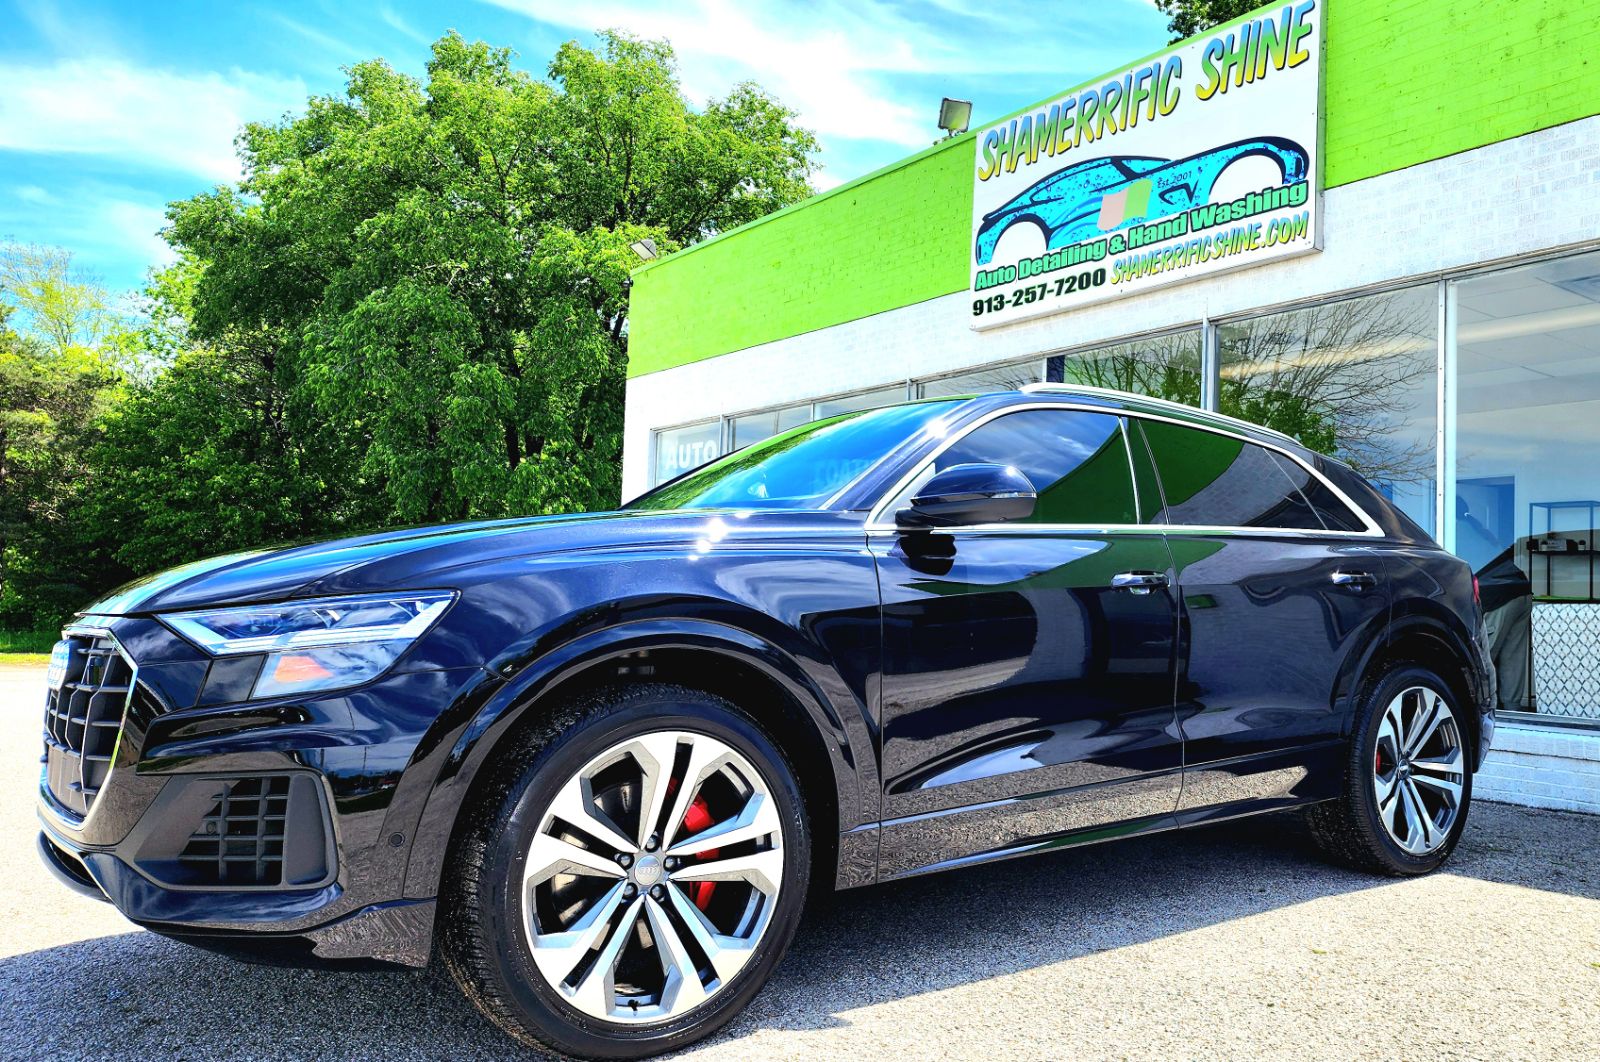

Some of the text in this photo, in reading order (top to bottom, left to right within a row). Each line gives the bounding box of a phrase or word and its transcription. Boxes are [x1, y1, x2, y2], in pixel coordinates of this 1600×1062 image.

[977, 0, 1316, 181] SHAMERRIFIC SHINE
[974, 179, 1309, 292] Auto Detailing & Hand Washing
[972, 268, 1107, 317] 913-257-7200
[665, 439, 718, 470] AUTO
